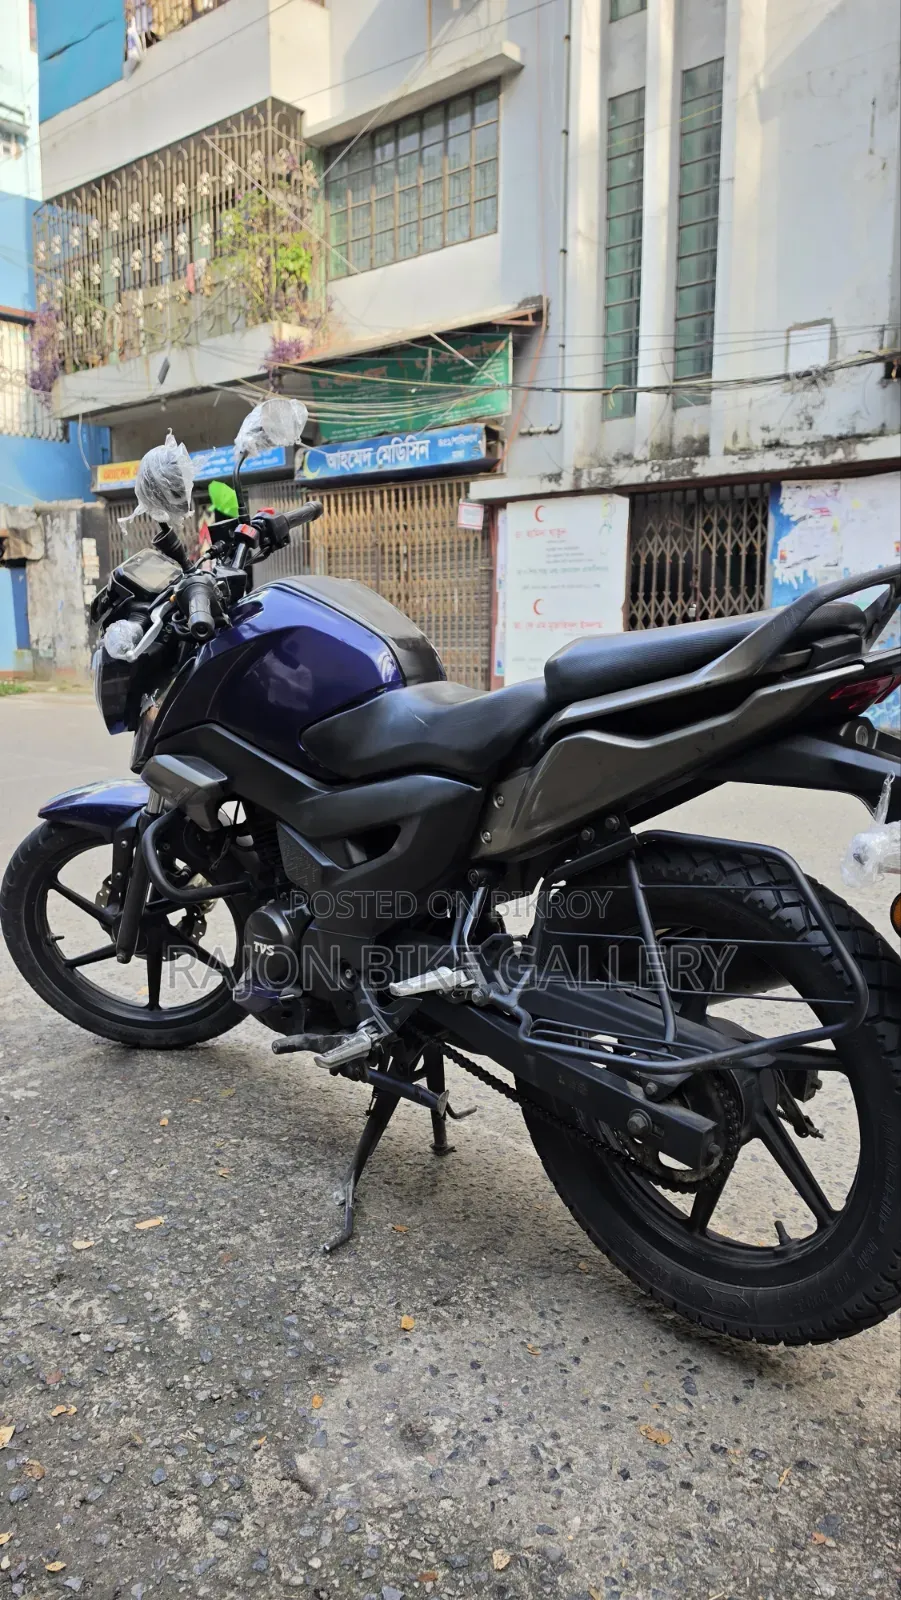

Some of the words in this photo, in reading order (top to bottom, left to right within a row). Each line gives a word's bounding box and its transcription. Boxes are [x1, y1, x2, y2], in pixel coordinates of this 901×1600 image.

[325, 446, 374, 471] আহমেদ
[375, 434, 431, 466] মেডিসিন
[253, 940, 275, 957] TVS
